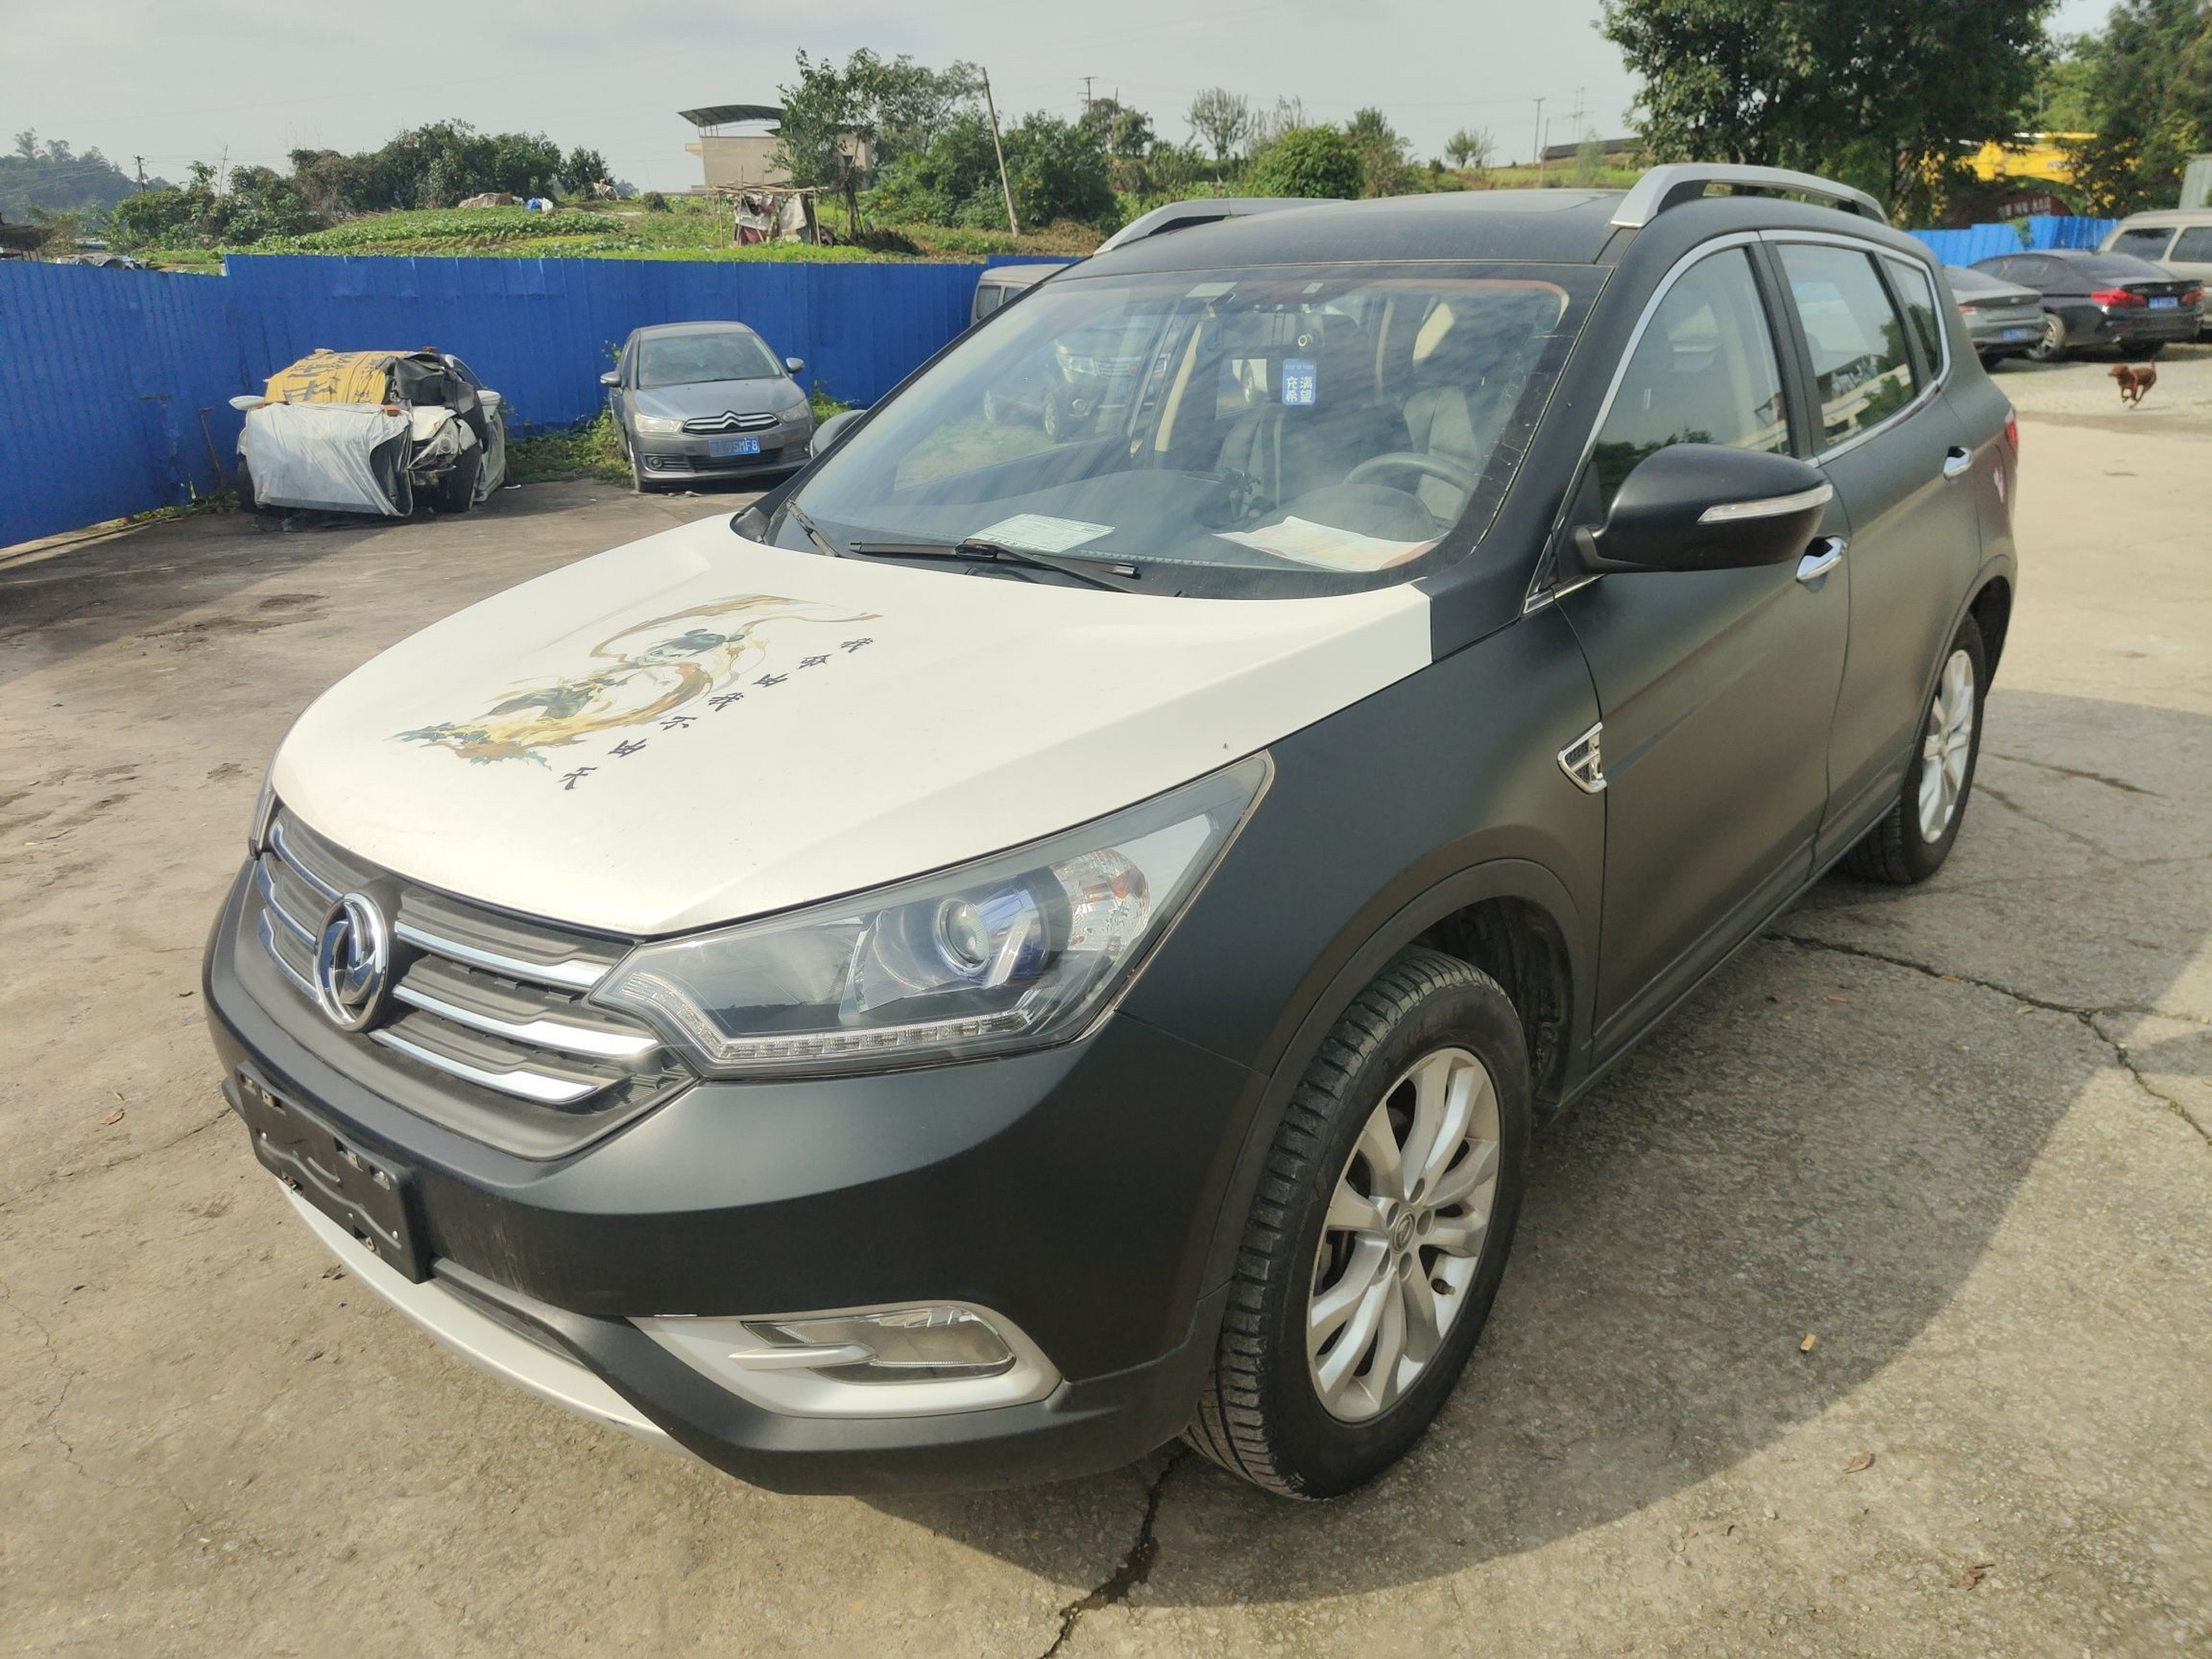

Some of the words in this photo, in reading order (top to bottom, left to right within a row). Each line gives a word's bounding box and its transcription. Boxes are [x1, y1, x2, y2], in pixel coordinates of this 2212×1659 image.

[1286, 376, 1313, 390] 充满
[1285, 390, 1312, 402] 希望
[711, 440, 758, 454] A95MF8
[557, 637, 873, 790] 我命由我不由天
